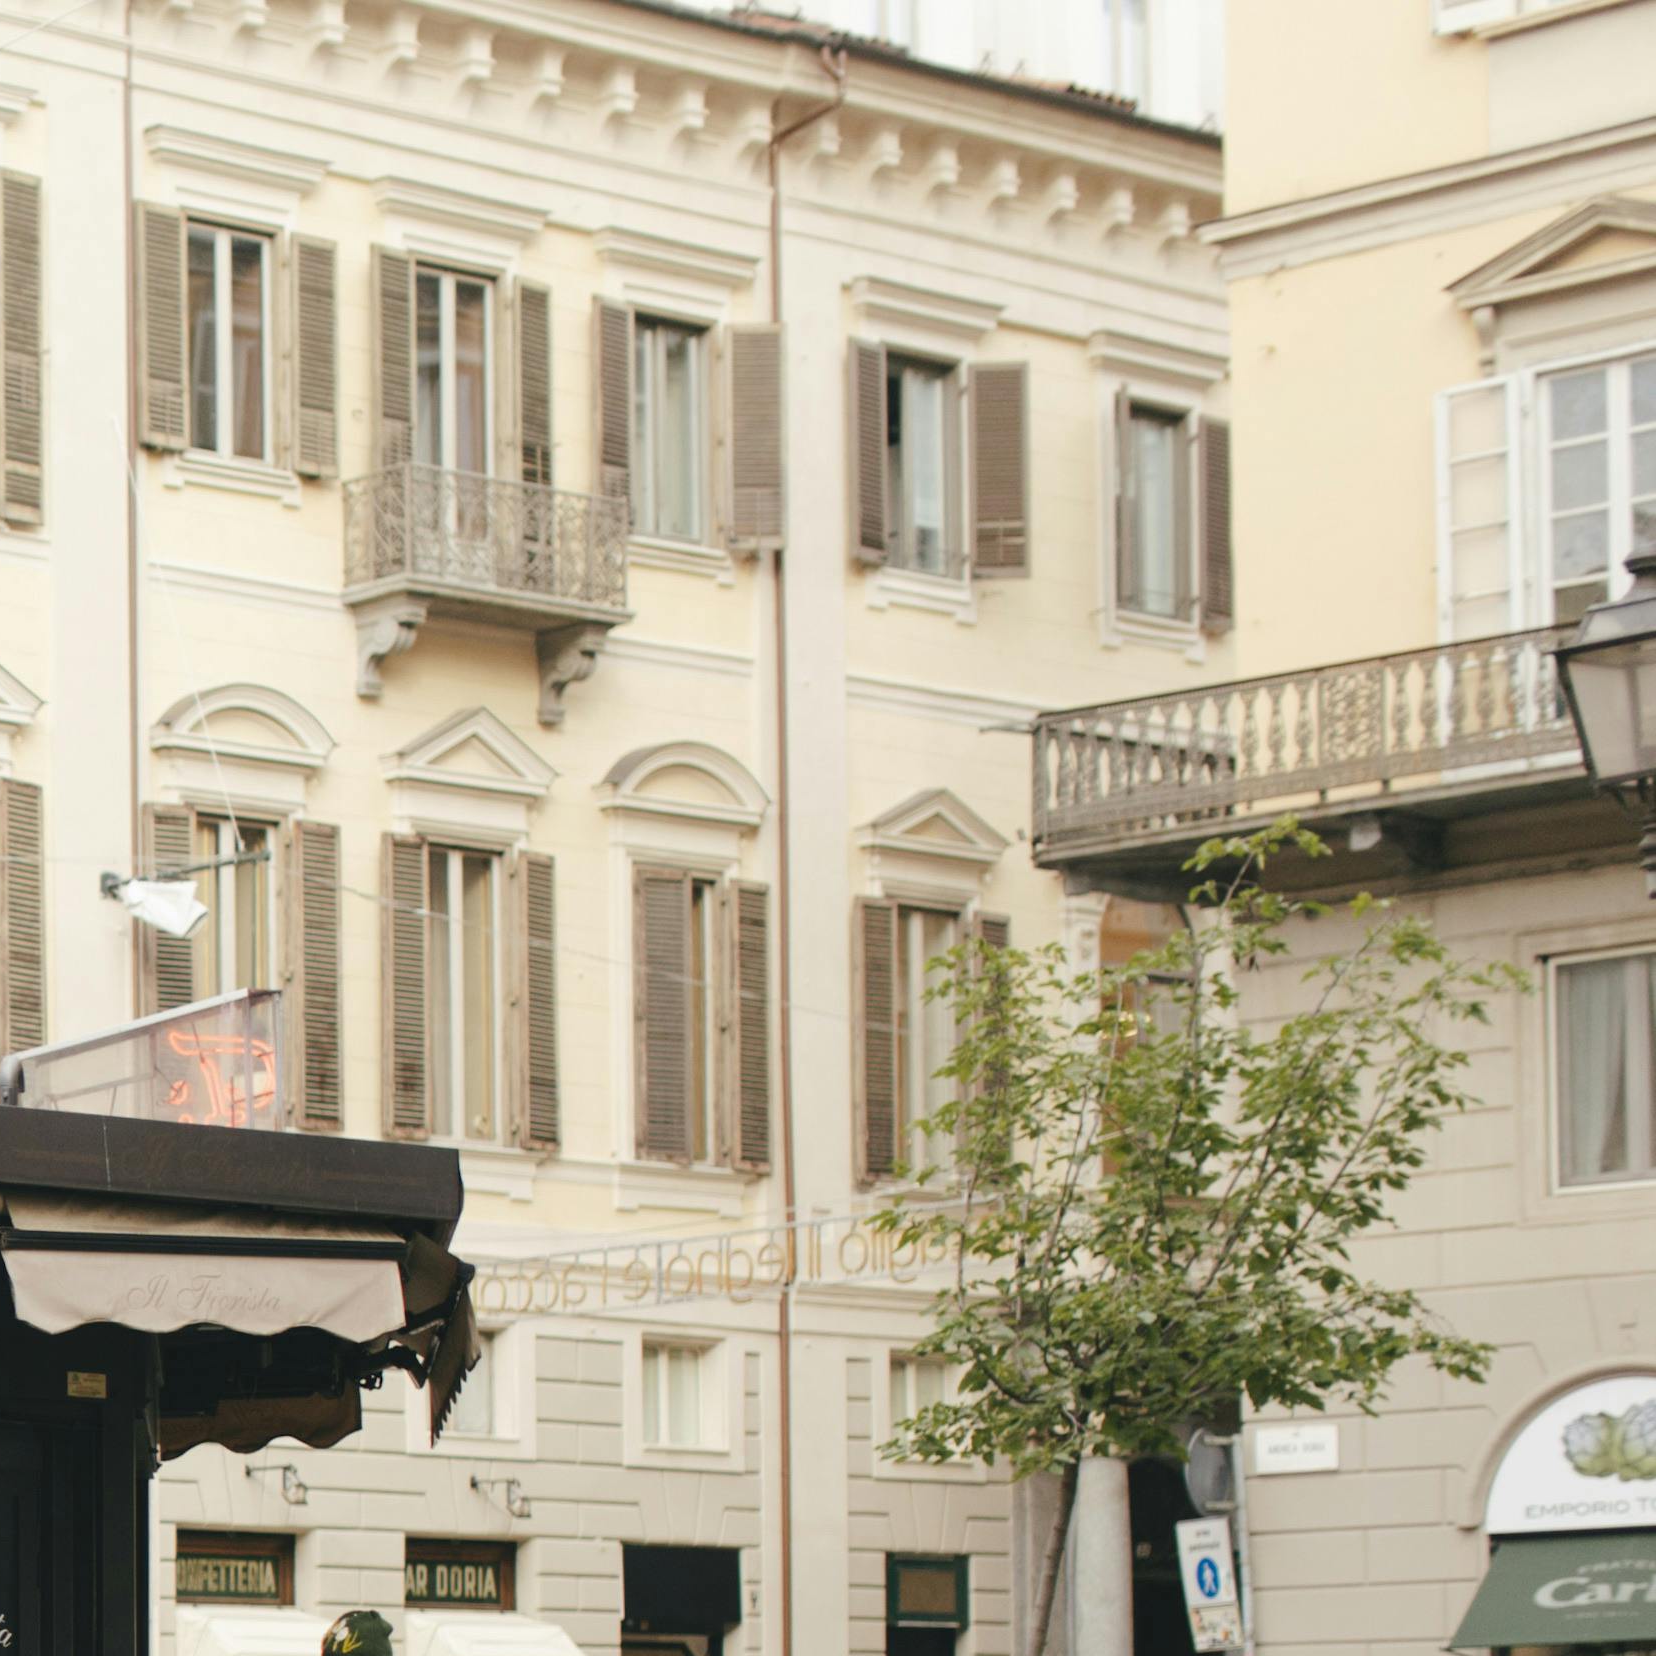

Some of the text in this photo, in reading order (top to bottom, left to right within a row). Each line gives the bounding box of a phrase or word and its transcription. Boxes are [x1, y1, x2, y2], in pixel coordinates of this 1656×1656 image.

[168, 1272, 281, 1317] Fiorista
[1524, 1500, 1631, 1520] EMPORIO
[177, 1558, 277, 1594] ONFETTERIA
[405, 1564, 497, 1599] AR DORIA
